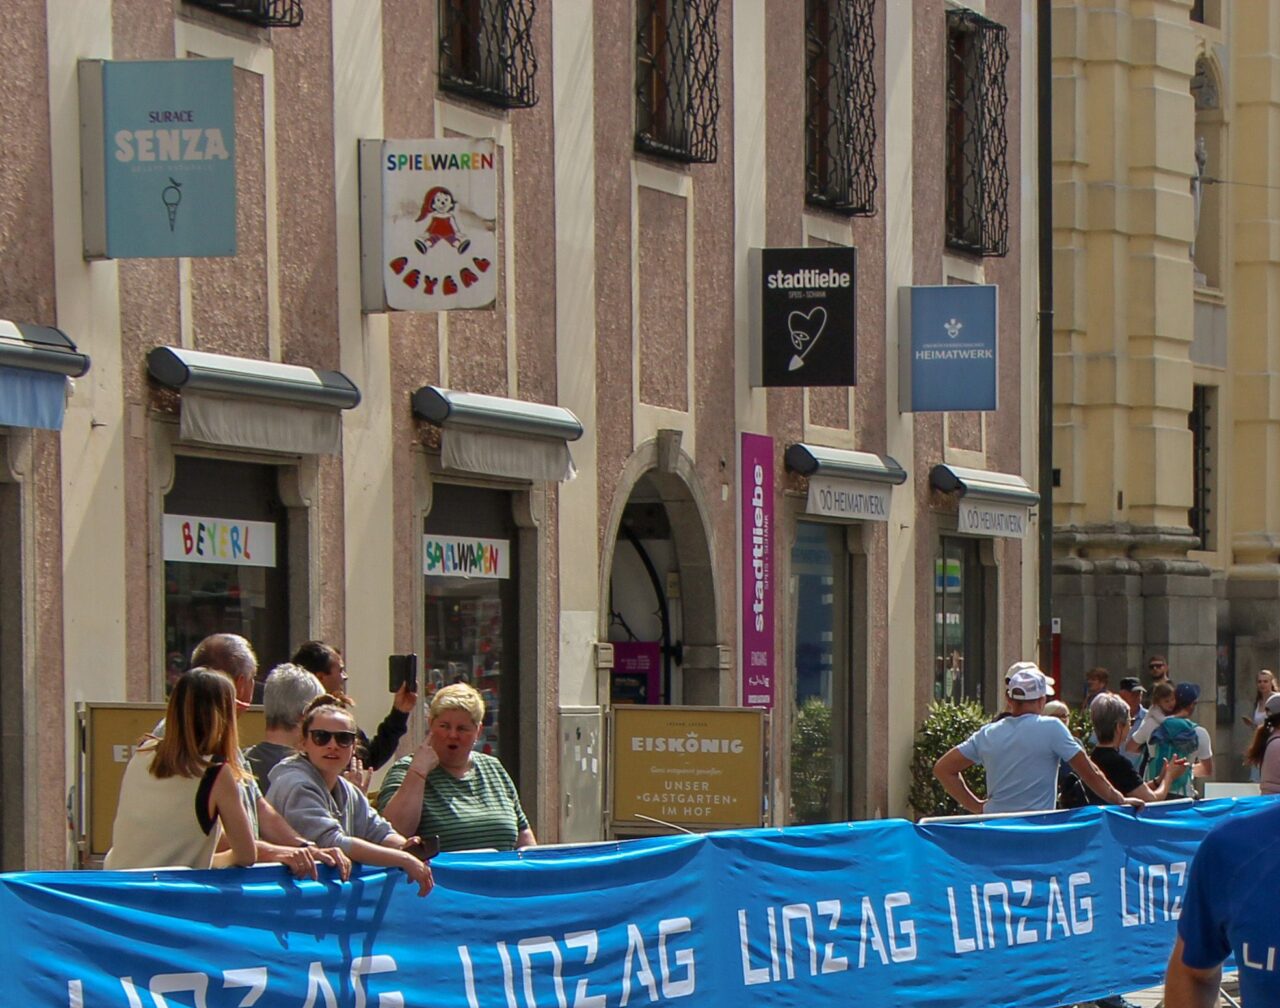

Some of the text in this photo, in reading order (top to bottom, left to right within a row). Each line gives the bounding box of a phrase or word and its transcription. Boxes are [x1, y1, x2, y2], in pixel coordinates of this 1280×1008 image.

[149, 110, 194, 123] SURACE
[115, 128, 229, 162] SENZA
[387, 153, 494, 171] SPIELWAREN
[768, 268, 851, 289] stadtliebe
[915, 349, 994, 361] HEIMATWERK
[820, 485, 885, 516] OÖ HEIMATWERK
[980, 511, 1022, 534] HEIMATWERK
[182, 520, 251, 560] BEYERL
[752, 464, 765, 632] stadtliebe
[427, 540, 498, 576] SPIELWAREN
[664, 780, 710, 791] UNSER
[662, 806, 713, 817] IM HOF
[946, 871, 1093, 954] LINZ AG
[737, 891, 919, 986] LINZ AG
[620, 917, 695, 1007] AG
